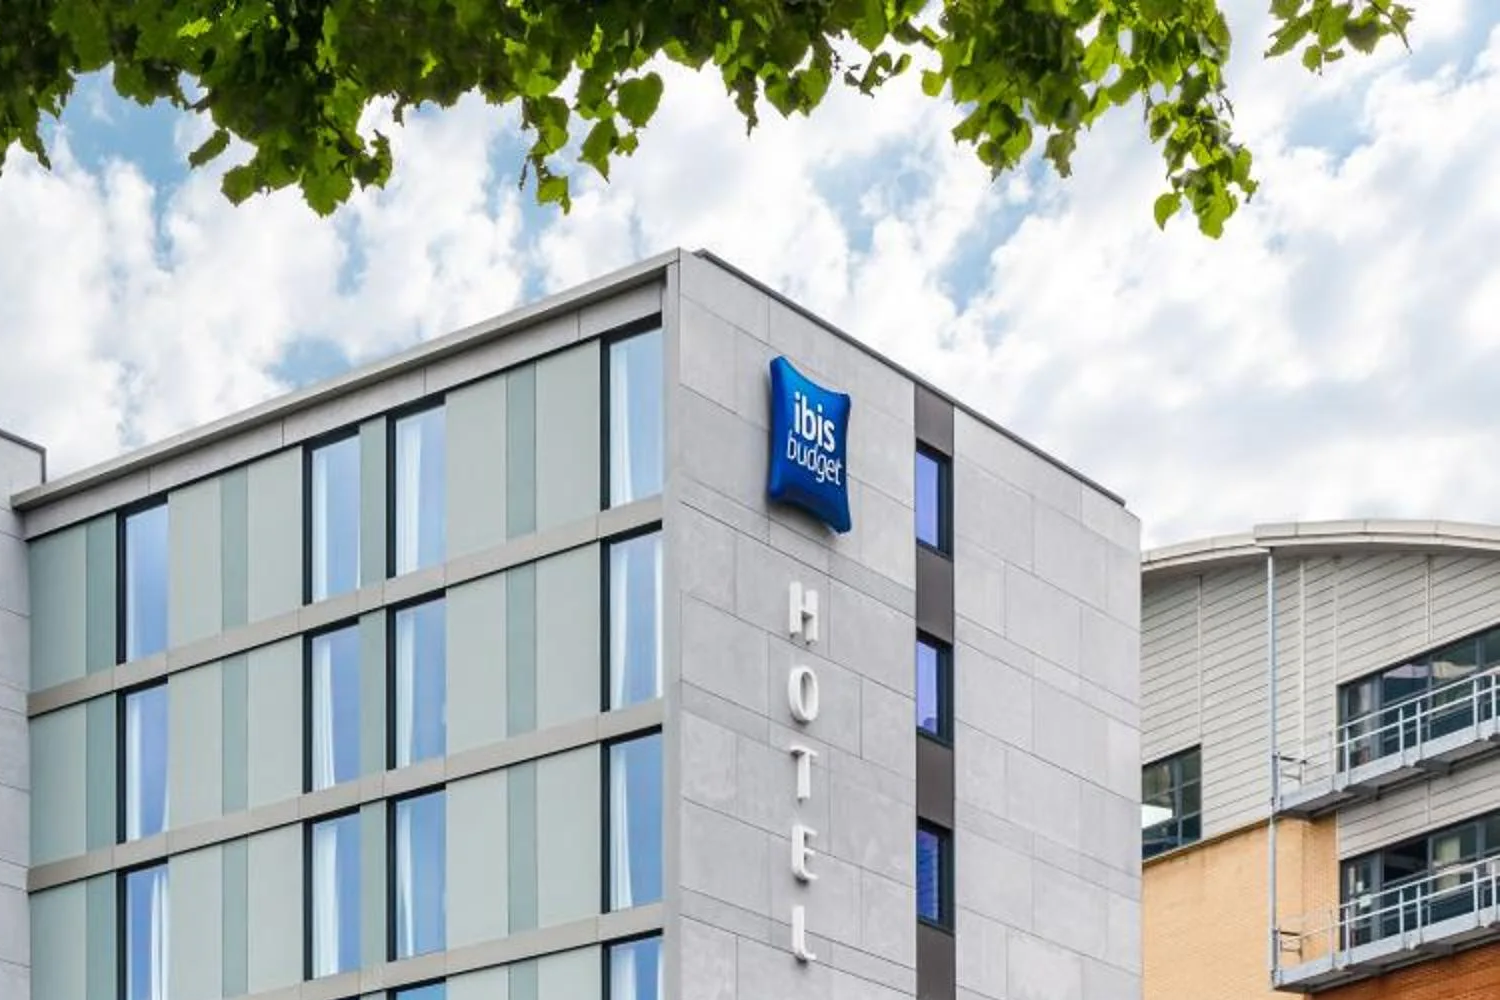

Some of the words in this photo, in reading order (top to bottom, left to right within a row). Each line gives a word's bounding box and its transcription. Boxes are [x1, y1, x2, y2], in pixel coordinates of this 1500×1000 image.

[794, 390, 836, 453] ibis
[786, 428, 842, 485] budget
[788, 580, 820, 962] HOTEL
